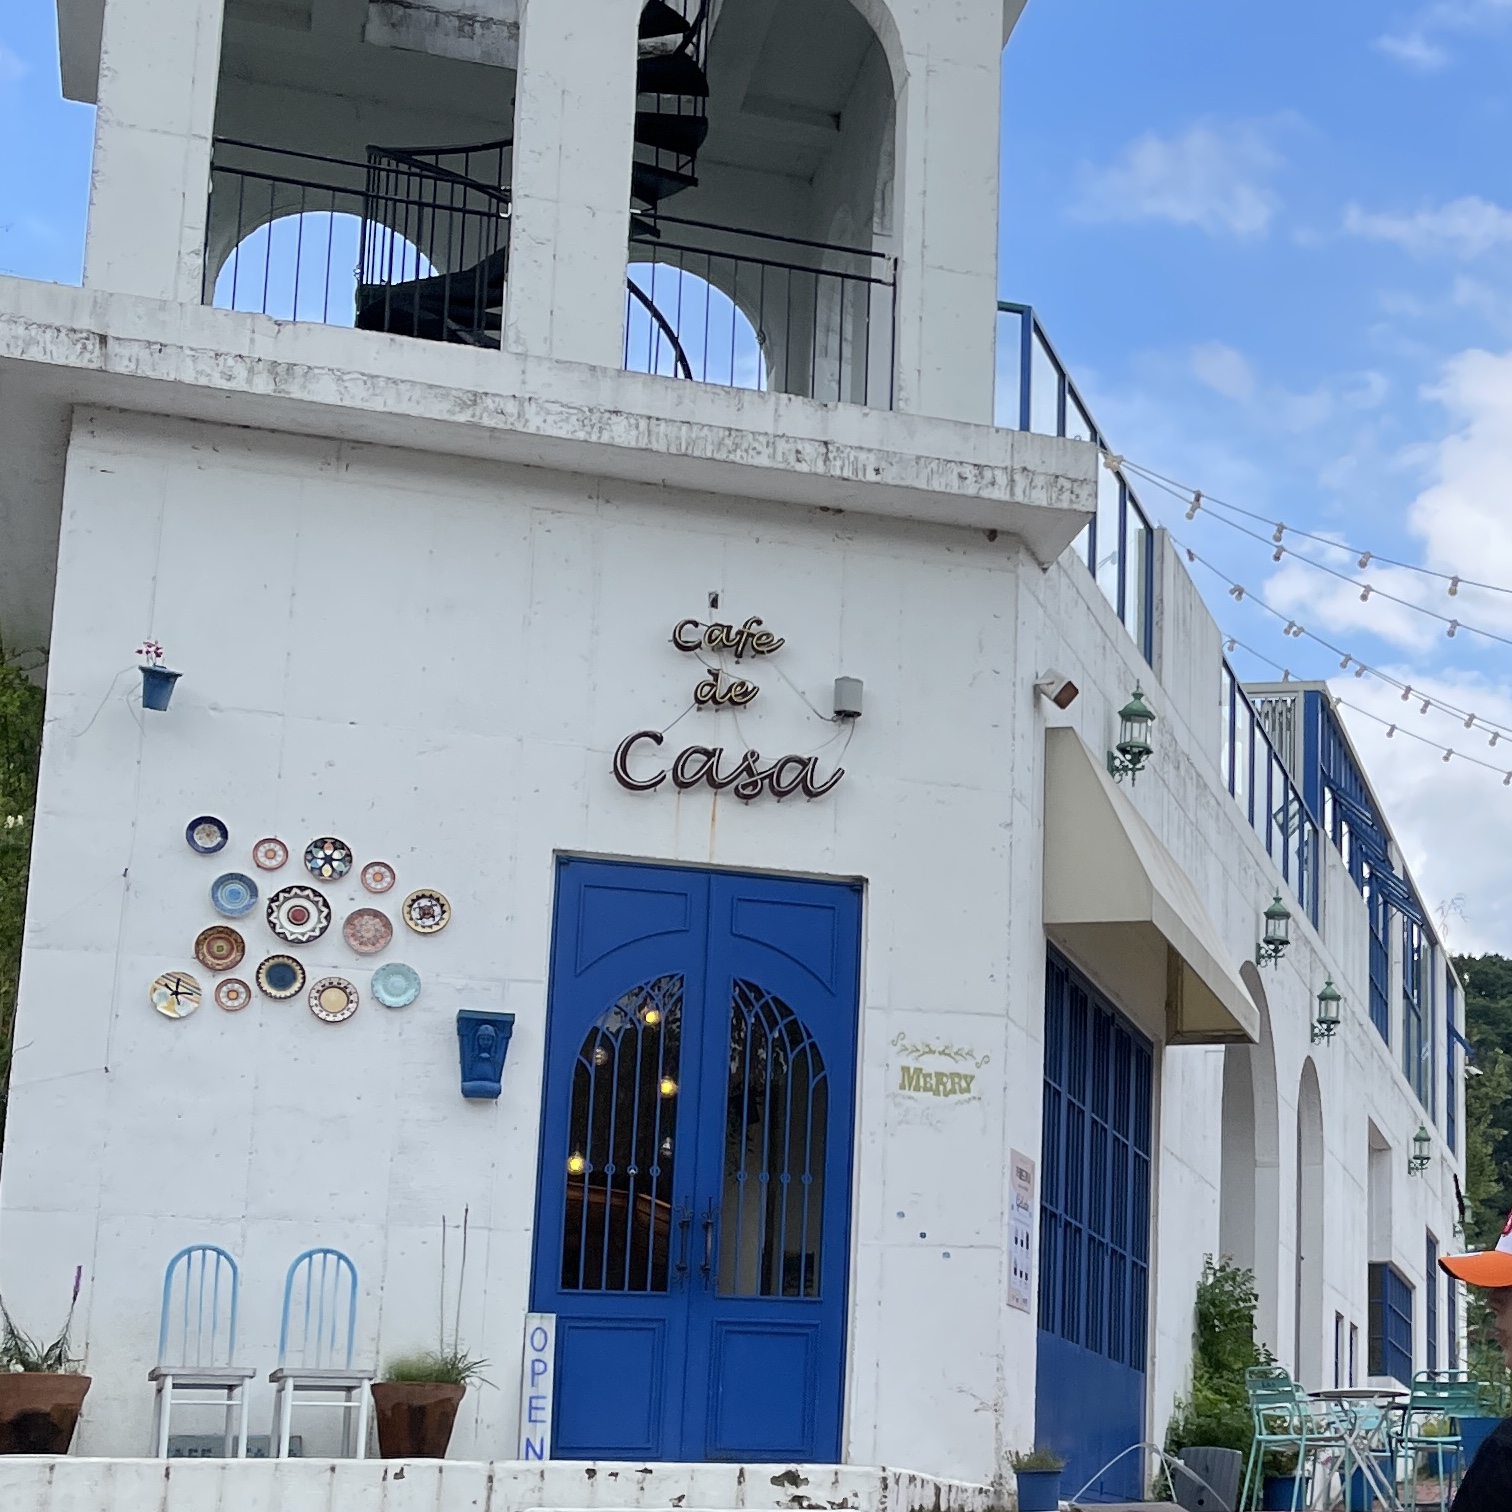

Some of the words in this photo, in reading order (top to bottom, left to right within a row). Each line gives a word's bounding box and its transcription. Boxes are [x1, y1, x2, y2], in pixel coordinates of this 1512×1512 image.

[694, 669, 759, 706] de
[613, 731, 845, 801] Casa
[525, 1326, 548, 1460] OPEN
